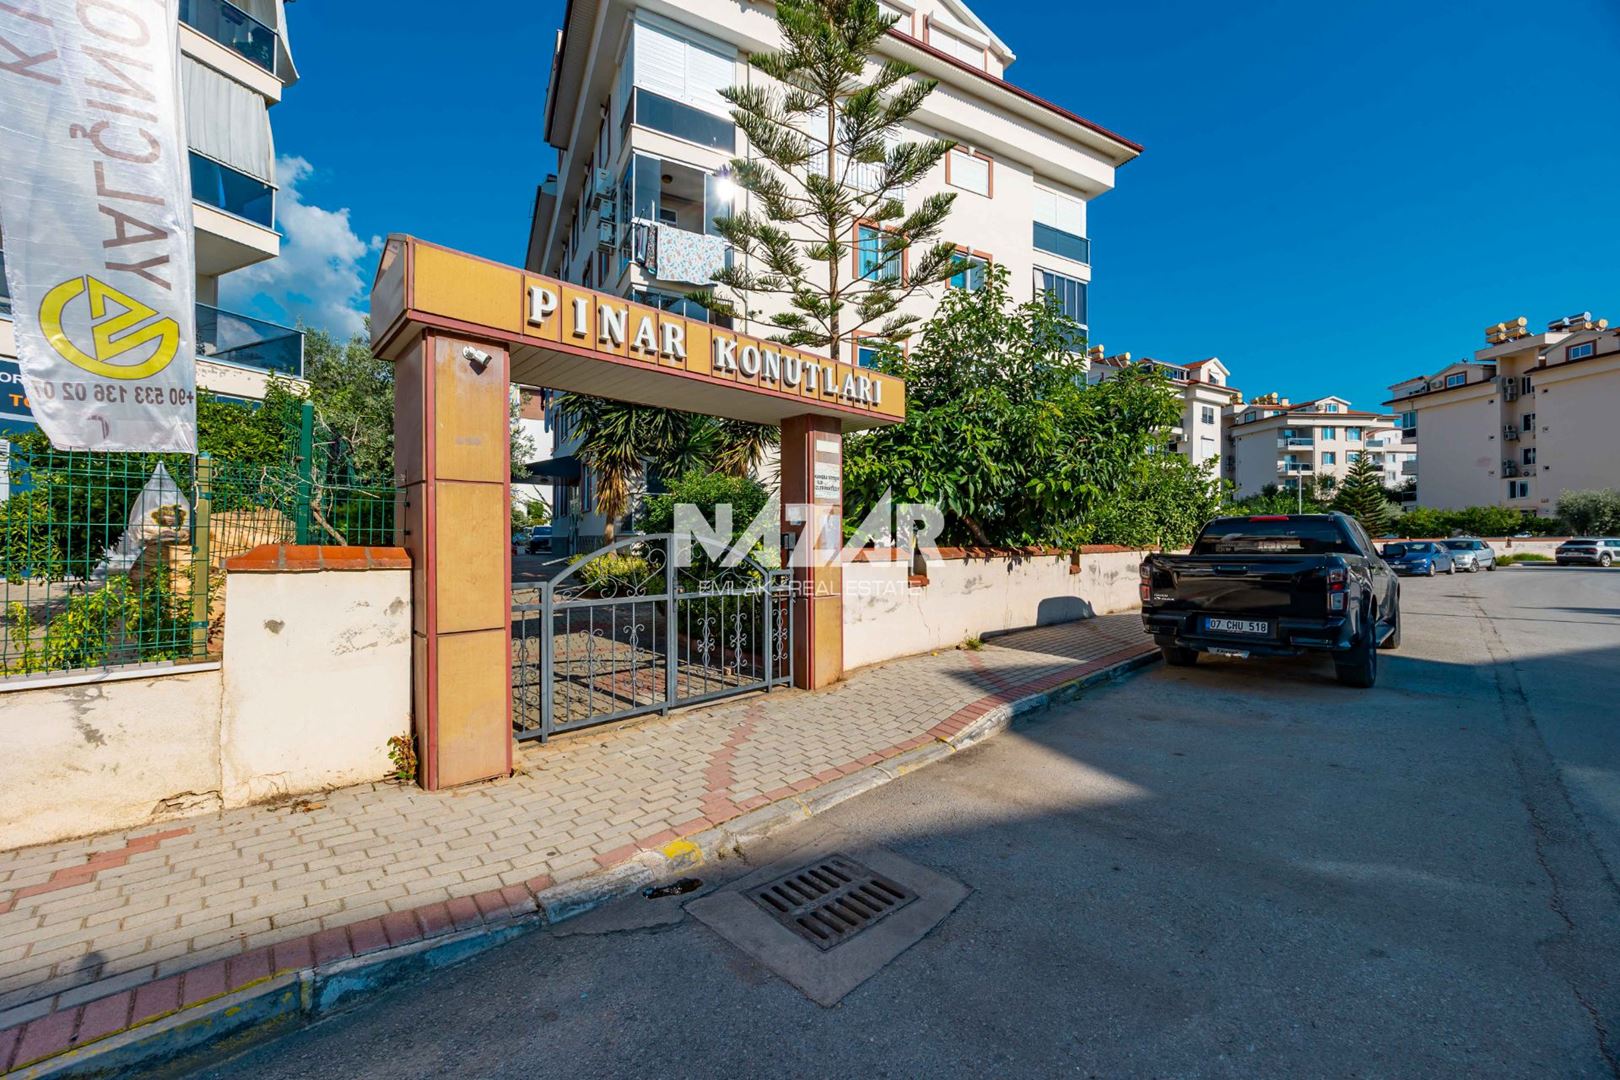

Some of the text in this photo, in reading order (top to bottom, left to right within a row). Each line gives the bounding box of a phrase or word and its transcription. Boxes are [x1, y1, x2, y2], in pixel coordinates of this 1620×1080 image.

[528, 285, 883, 404] PINAR KONUTLARI
[1210, 619, 1266, 632] 07 CHU 518
